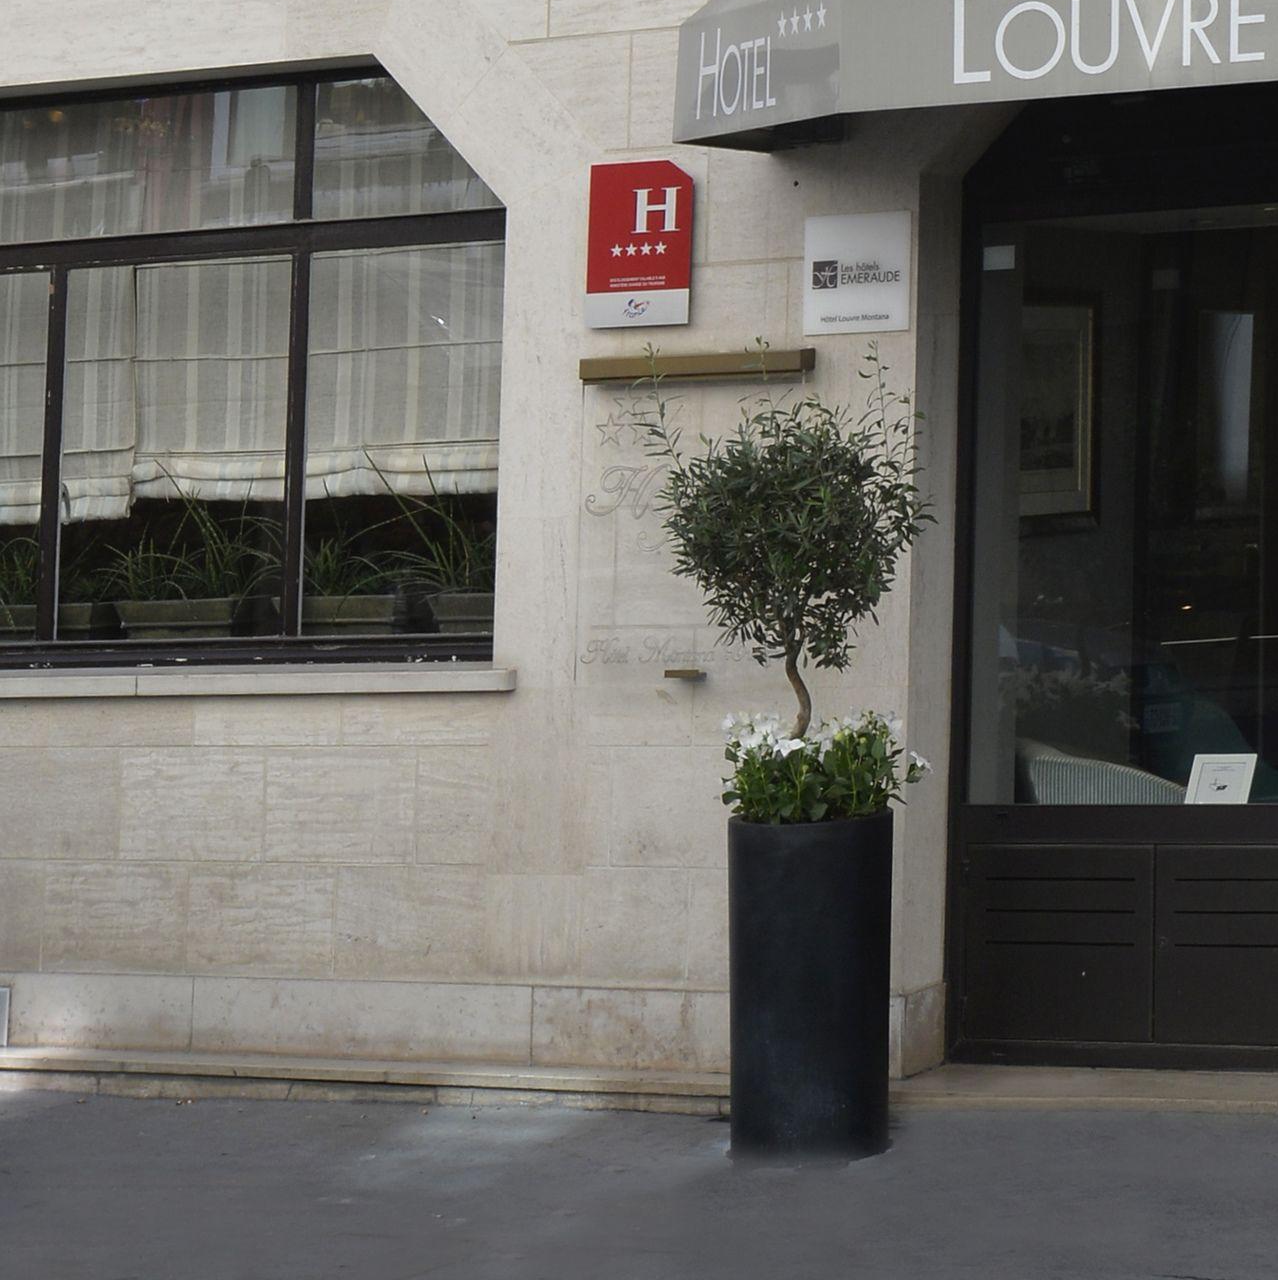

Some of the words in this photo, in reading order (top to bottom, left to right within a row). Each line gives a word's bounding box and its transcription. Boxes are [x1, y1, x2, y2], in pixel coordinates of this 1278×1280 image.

[695, 28, 777, 120] HOTEL
[630, 186, 683, 234] H
[841, 271, 900, 284] EMERAUDE
